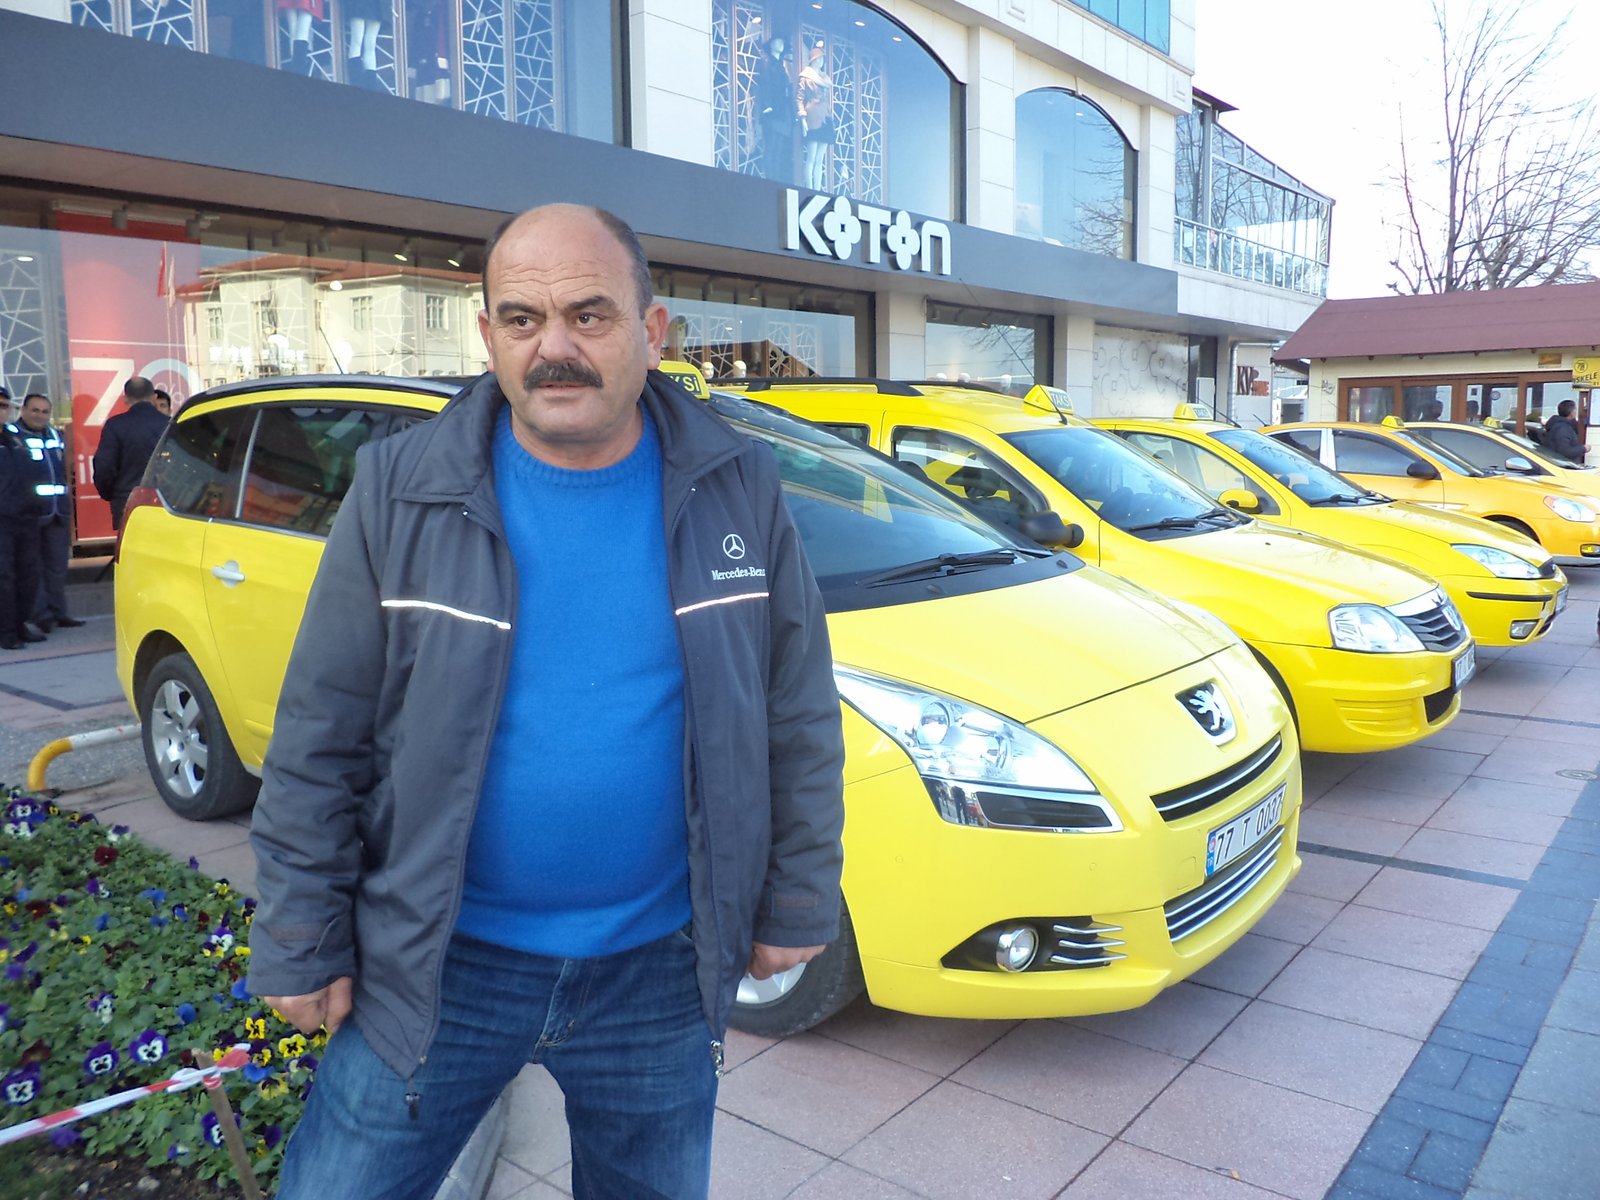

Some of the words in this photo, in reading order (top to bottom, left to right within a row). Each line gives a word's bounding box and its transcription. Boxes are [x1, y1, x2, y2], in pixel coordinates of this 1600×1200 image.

[786, 188, 951, 275] KOTON
[1216, 827, 1234, 865] 77
[1243, 817, 1251, 846] T
[1256, 791, 1283, 836] 0037
